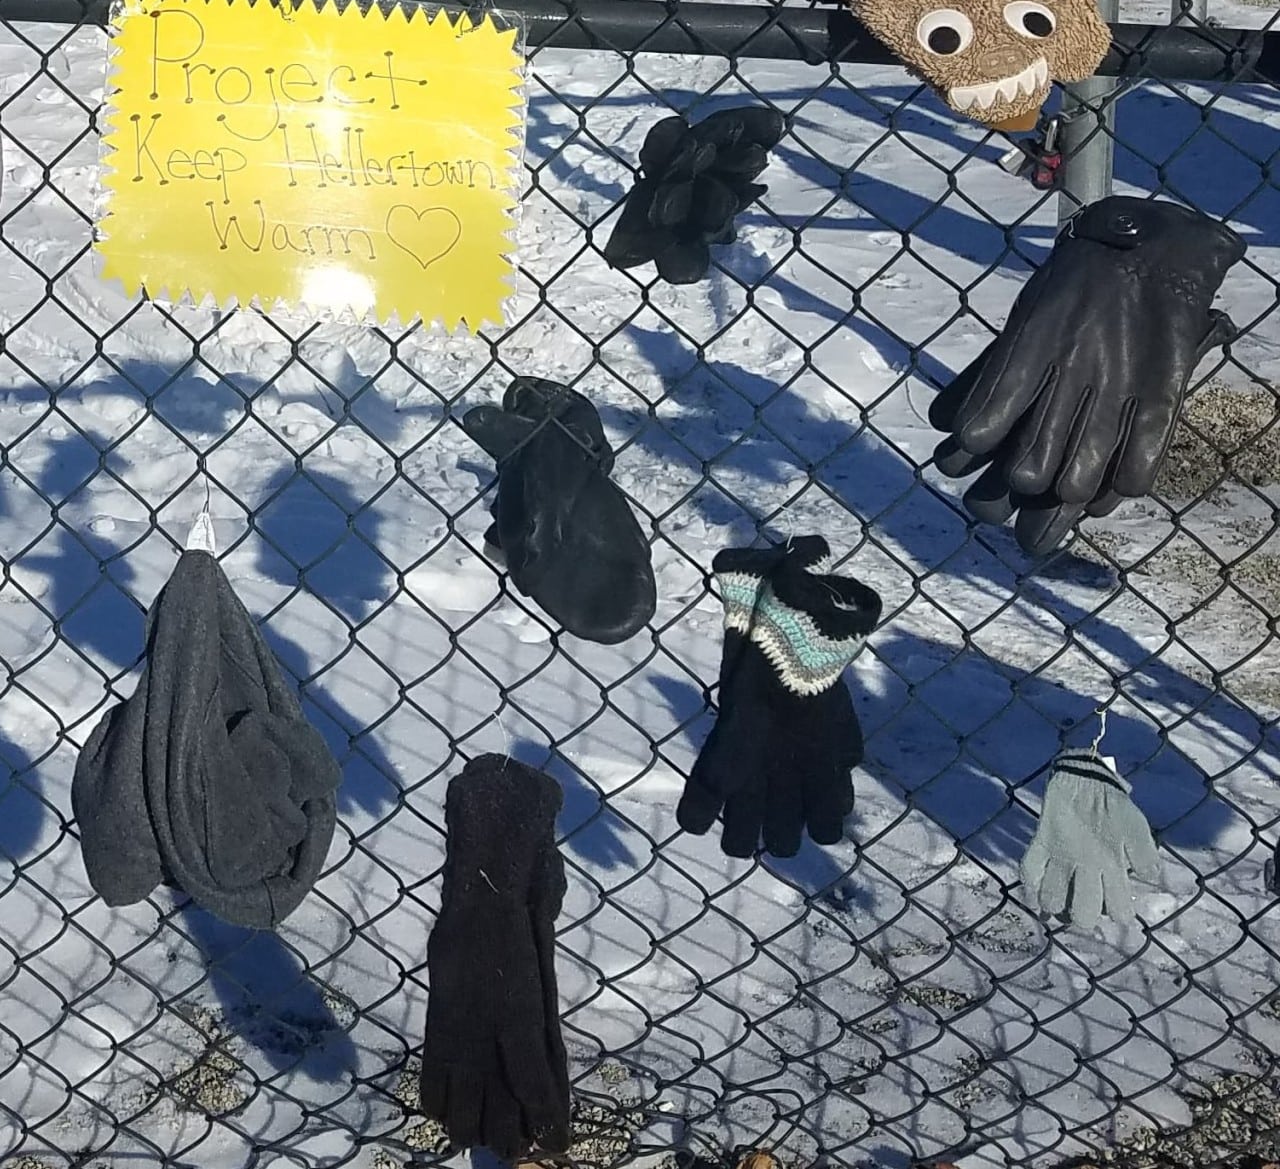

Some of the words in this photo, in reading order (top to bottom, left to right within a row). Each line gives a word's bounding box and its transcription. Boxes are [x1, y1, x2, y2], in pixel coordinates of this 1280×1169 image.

[147, 9, 429, 141] Project
[130, 113, 248, 204] Keep
[278, 122, 498, 189] Hellertown
[205, 199, 378, 260] Warm
